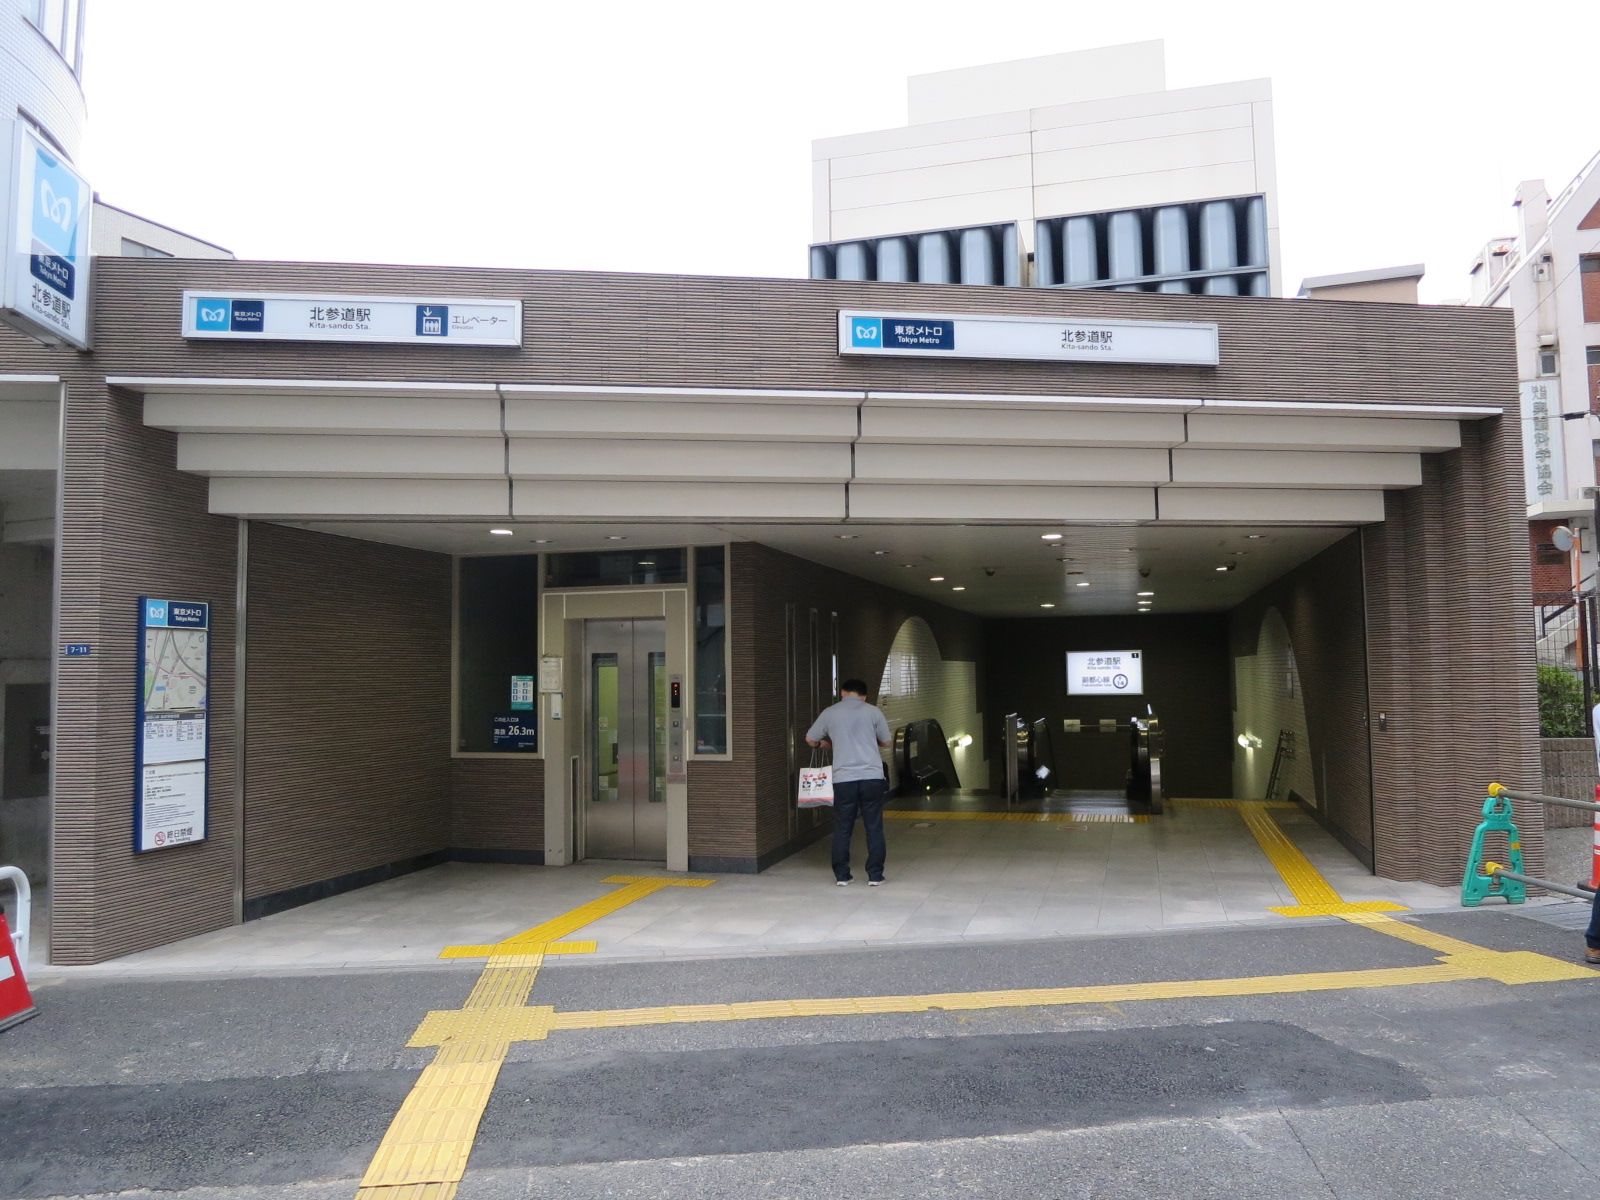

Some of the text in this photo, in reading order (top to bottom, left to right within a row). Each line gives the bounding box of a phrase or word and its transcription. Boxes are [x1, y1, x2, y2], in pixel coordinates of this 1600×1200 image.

[32, 283, 71, 320] 北参道駅
[310, 306, 371, 322] 北参道駅
[452, 315, 508, 325] エレベーター
[309, 322, 353, 330] Kita-sando
[894, 325, 942, 336] 東京メトロ
[897, 336, 918, 344] Tokyo
[1061, 329, 1113, 343] 北参道駅
[1061, 343, 1099, 351] Kita-sando
[173, 607, 202, 616] 東京メトロ
[1087, 656, 1121, 666] 北参道駅
[508, 725, 535, 736] 26.3m
[167, 826, 193, 839] 終日禁煙
